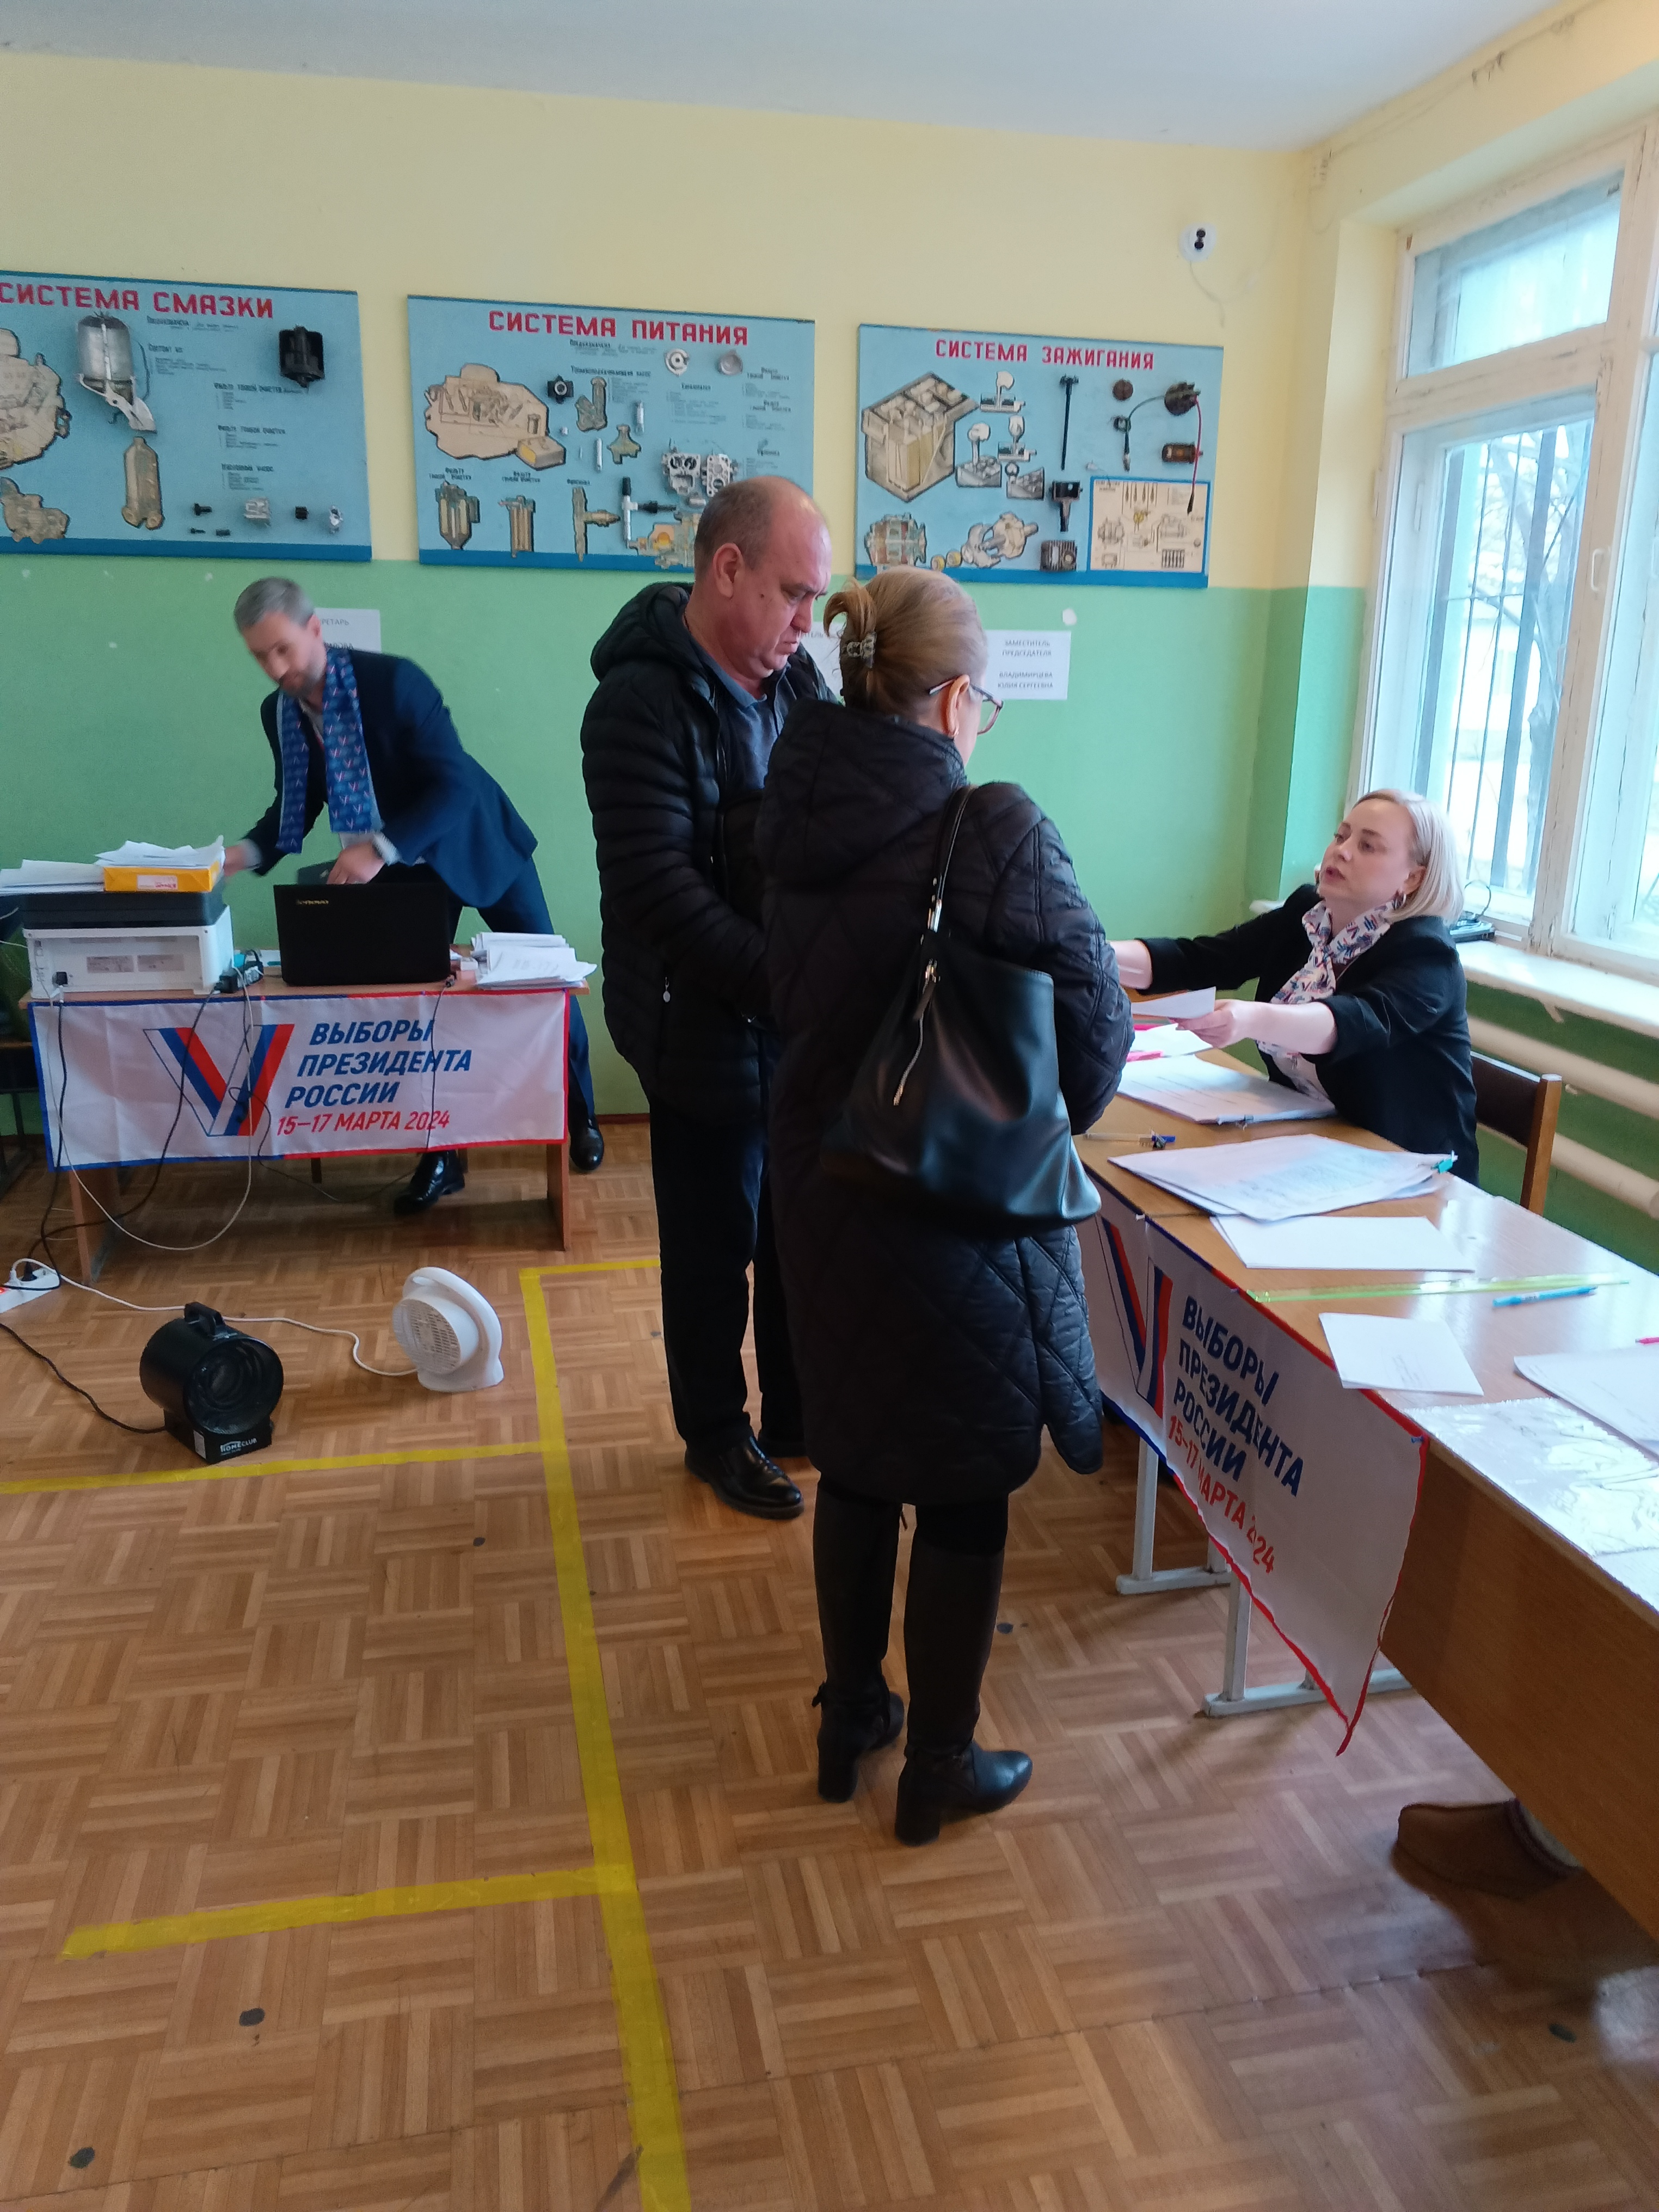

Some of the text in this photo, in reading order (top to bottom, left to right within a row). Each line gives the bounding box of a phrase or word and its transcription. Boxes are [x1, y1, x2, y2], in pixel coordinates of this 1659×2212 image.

[0, 282, 273, 319] СИСТЕМА СМАЗКИ
[488, 310, 748, 346] СИСТЕМА ПИТАНИЯ
[936, 339, 1154, 371] СИСТЕМА ЗАЖИГАНИЯ
[309, 1019, 434, 1046] ВЫБОРЫ
[297, 1049, 472, 1077] ПРЕЗИДЕНТА
[284, 1082, 401, 1109] РОССИИ
[333, 1110, 402, 1132] МАРТА
[403, 1109, 450, 1131] 2024
[1182, 1295, 1279, 1407] ВЫБОРЫ
[1173, 1377, 1247, 1482] РОССИИ
[1178, 1337, 1304, 1498] ПРЕЗИДЕНТА
[1246, 1514, 1275, 1575] 024
